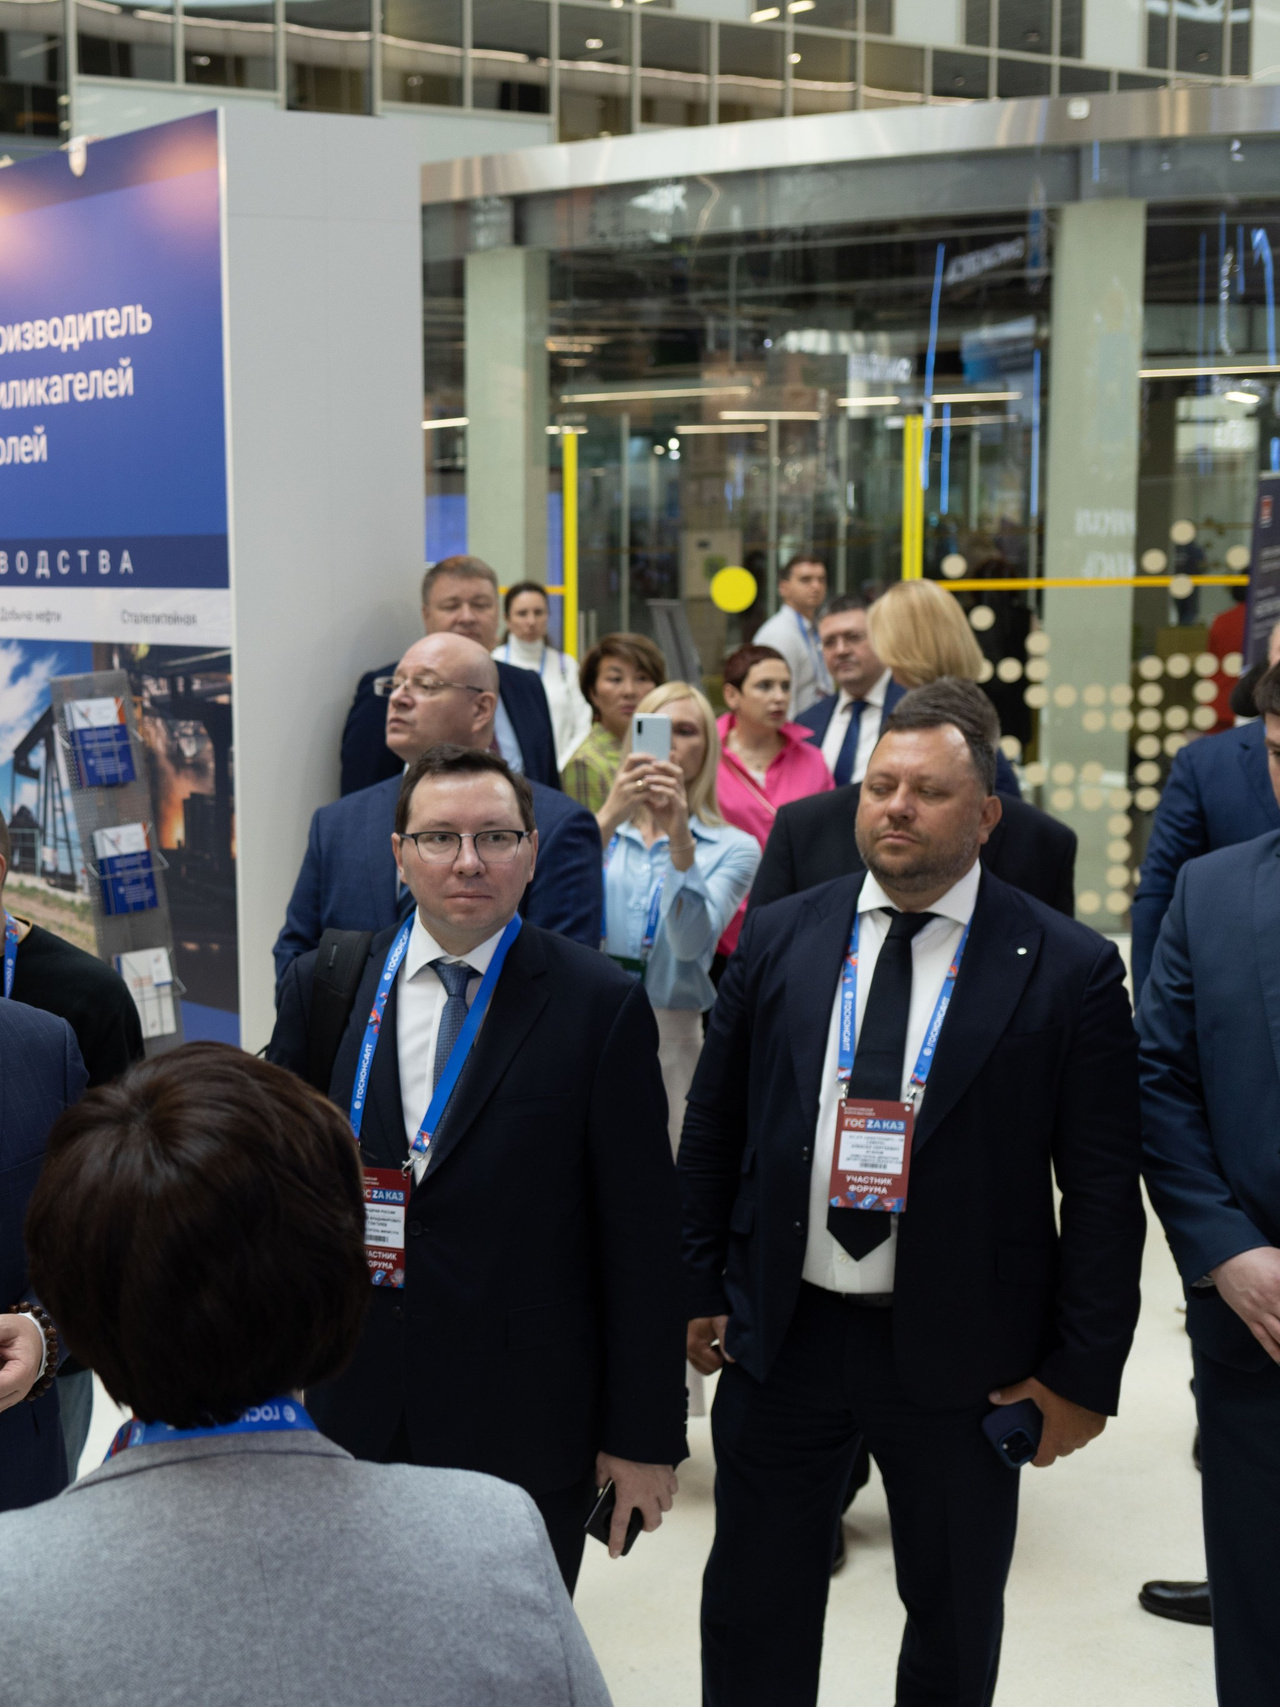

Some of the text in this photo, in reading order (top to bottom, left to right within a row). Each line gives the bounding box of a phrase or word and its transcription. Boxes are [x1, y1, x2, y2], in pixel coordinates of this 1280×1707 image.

[356, 1043, 373, 1099] ГОСКОНСАЛТ
[846, 1175, 892, 1185] УЧАСТНИК
[848, 1184, 888, 1194] ФОРУМА
[366, 1250, 397, 1260] АСТНИК
[368, 1261, 393, 1270] ОРУМА
